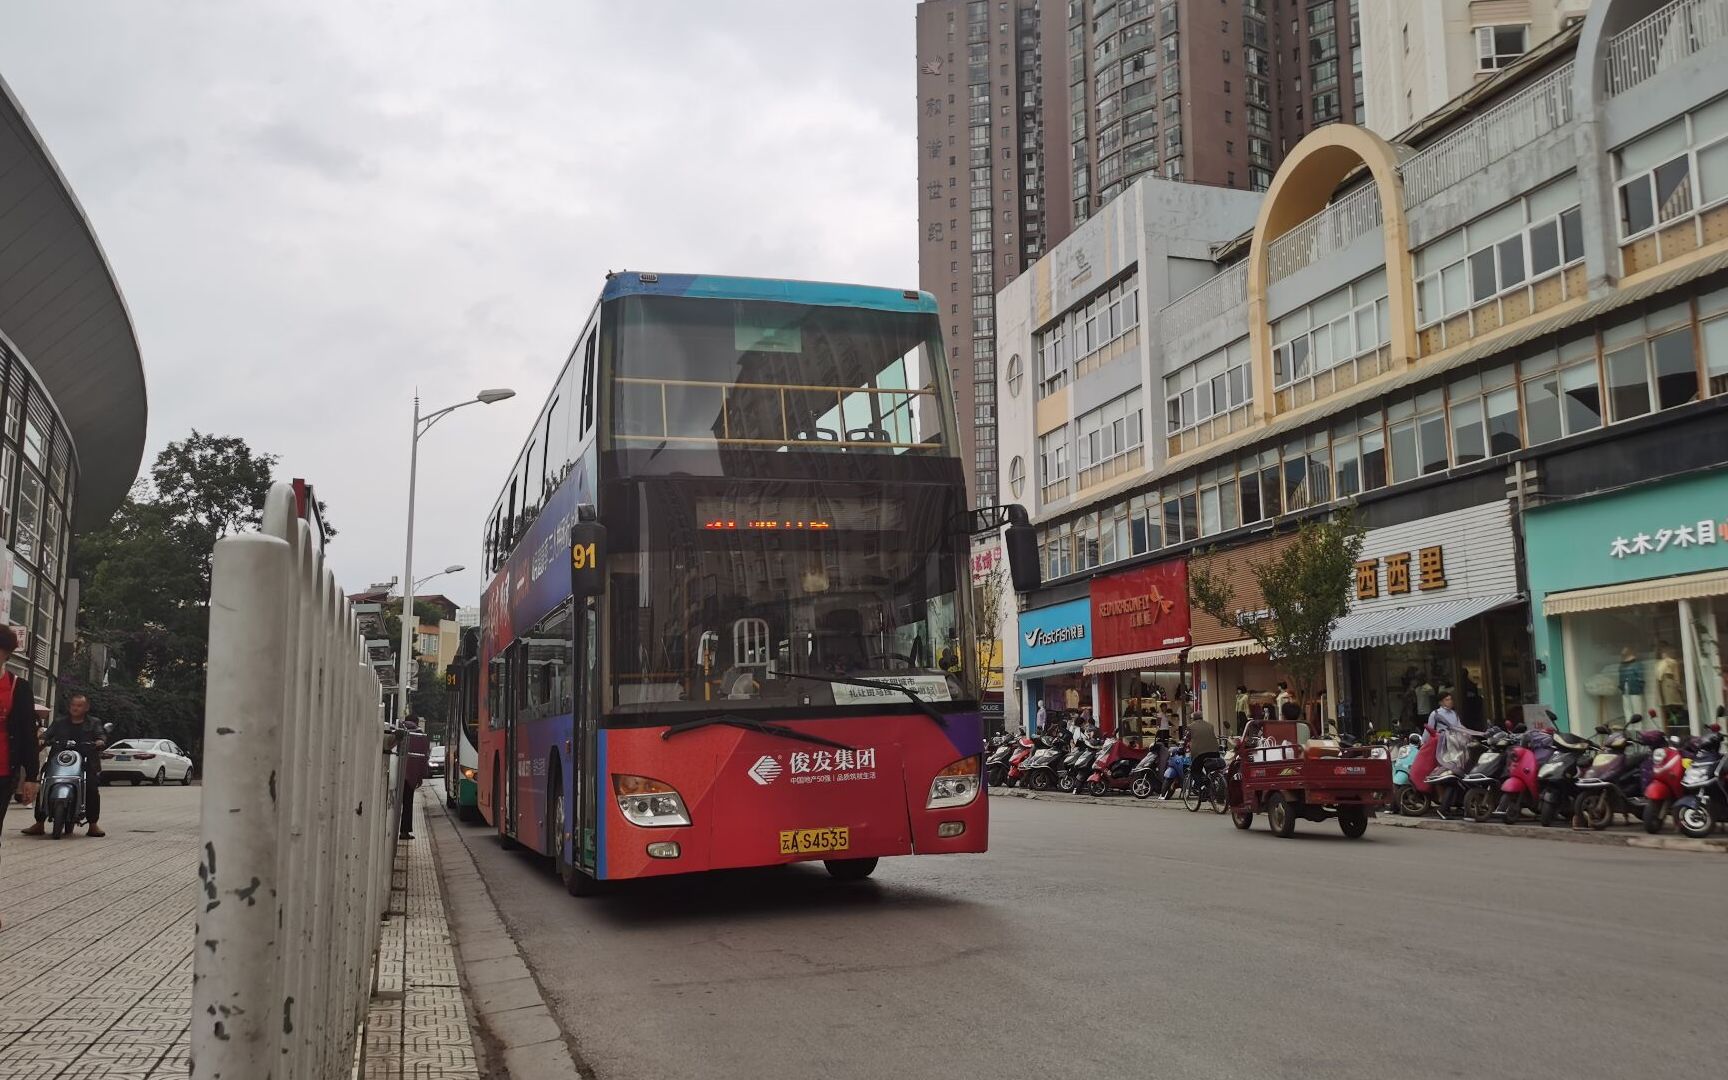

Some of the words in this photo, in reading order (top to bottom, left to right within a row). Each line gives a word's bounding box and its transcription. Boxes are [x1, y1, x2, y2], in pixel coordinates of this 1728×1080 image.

[1610, 520, 1716, 558] 木木夕木目
[573, 543, 596, 569] 91
[1354, 545, 1446, 600] 西西里
[447, 674, 456, 685] 91
[789, 747, 876, 774] 俊发集团
